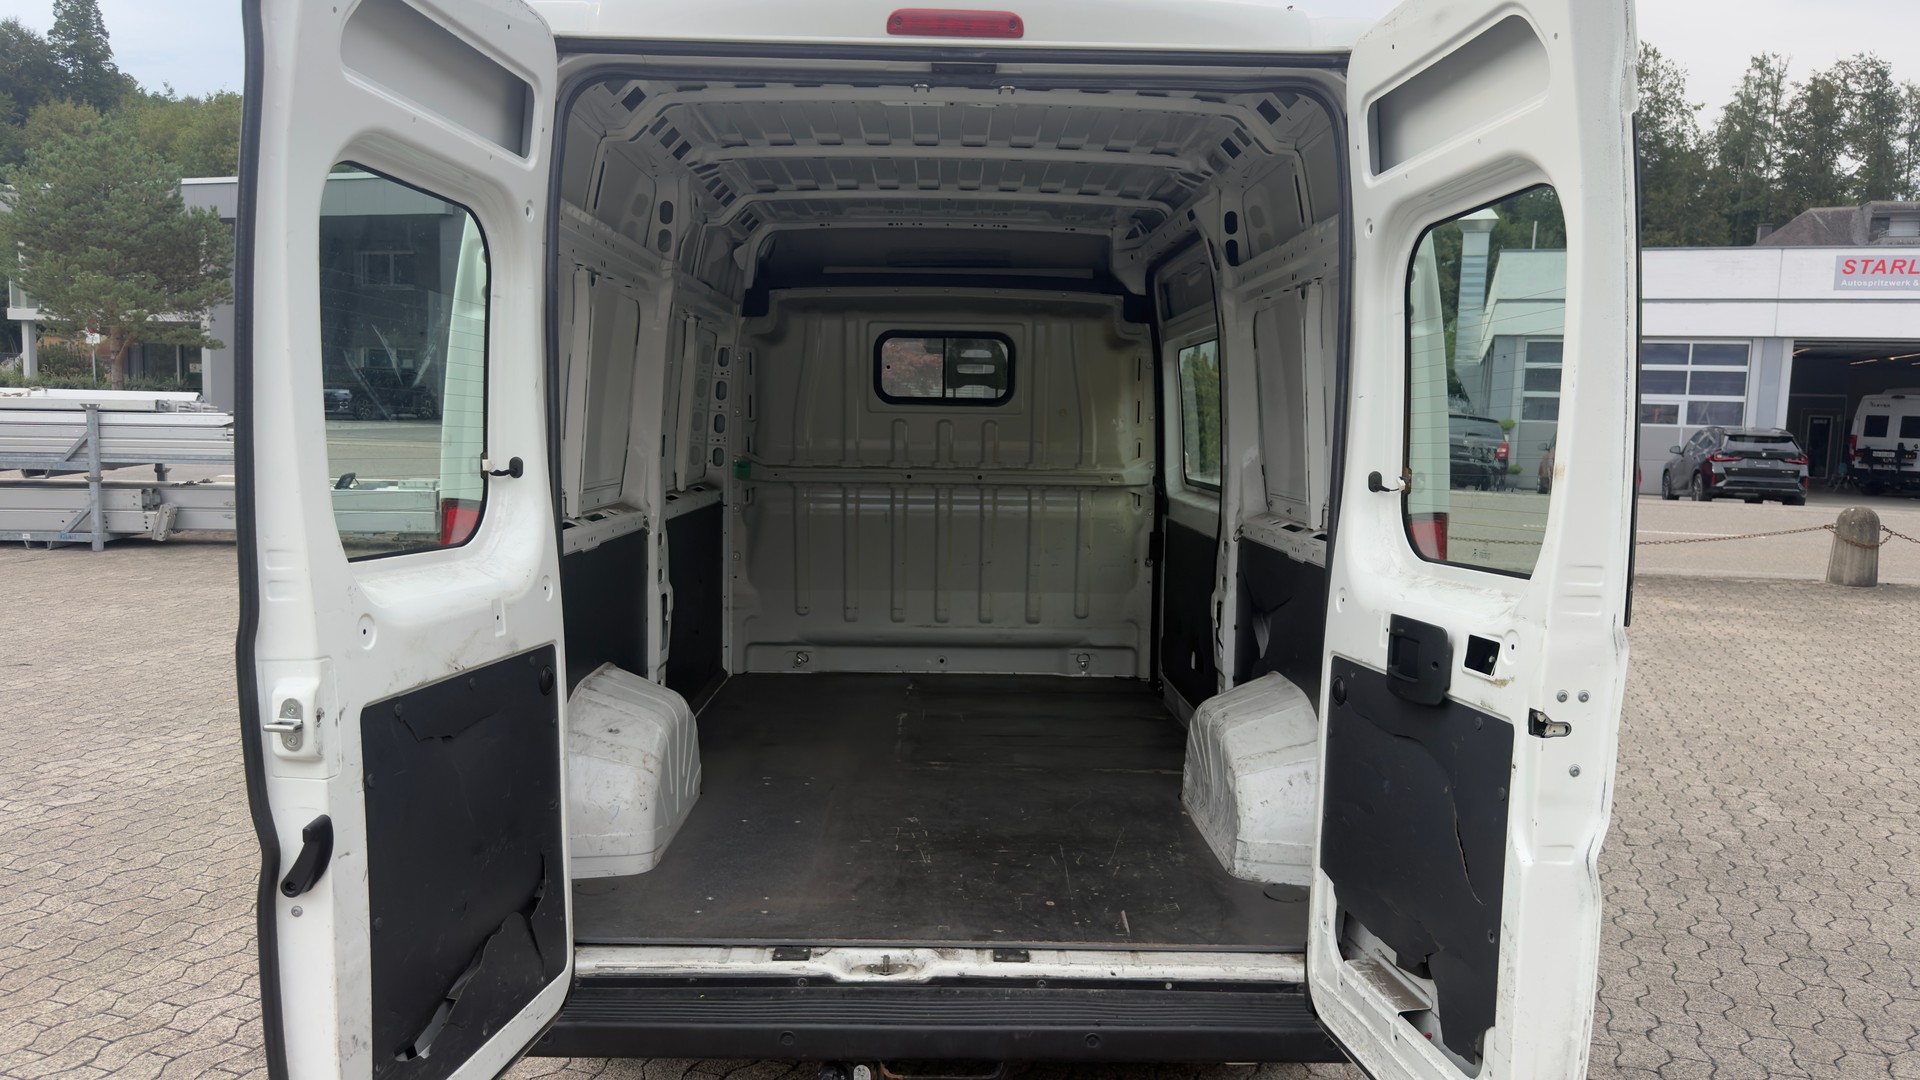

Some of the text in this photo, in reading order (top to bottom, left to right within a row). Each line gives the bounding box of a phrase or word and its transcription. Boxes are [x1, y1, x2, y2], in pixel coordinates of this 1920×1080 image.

[1842, 259, 1920, 275] STARL
[1841, 279, 1919, 288] Autospritzwerk &
